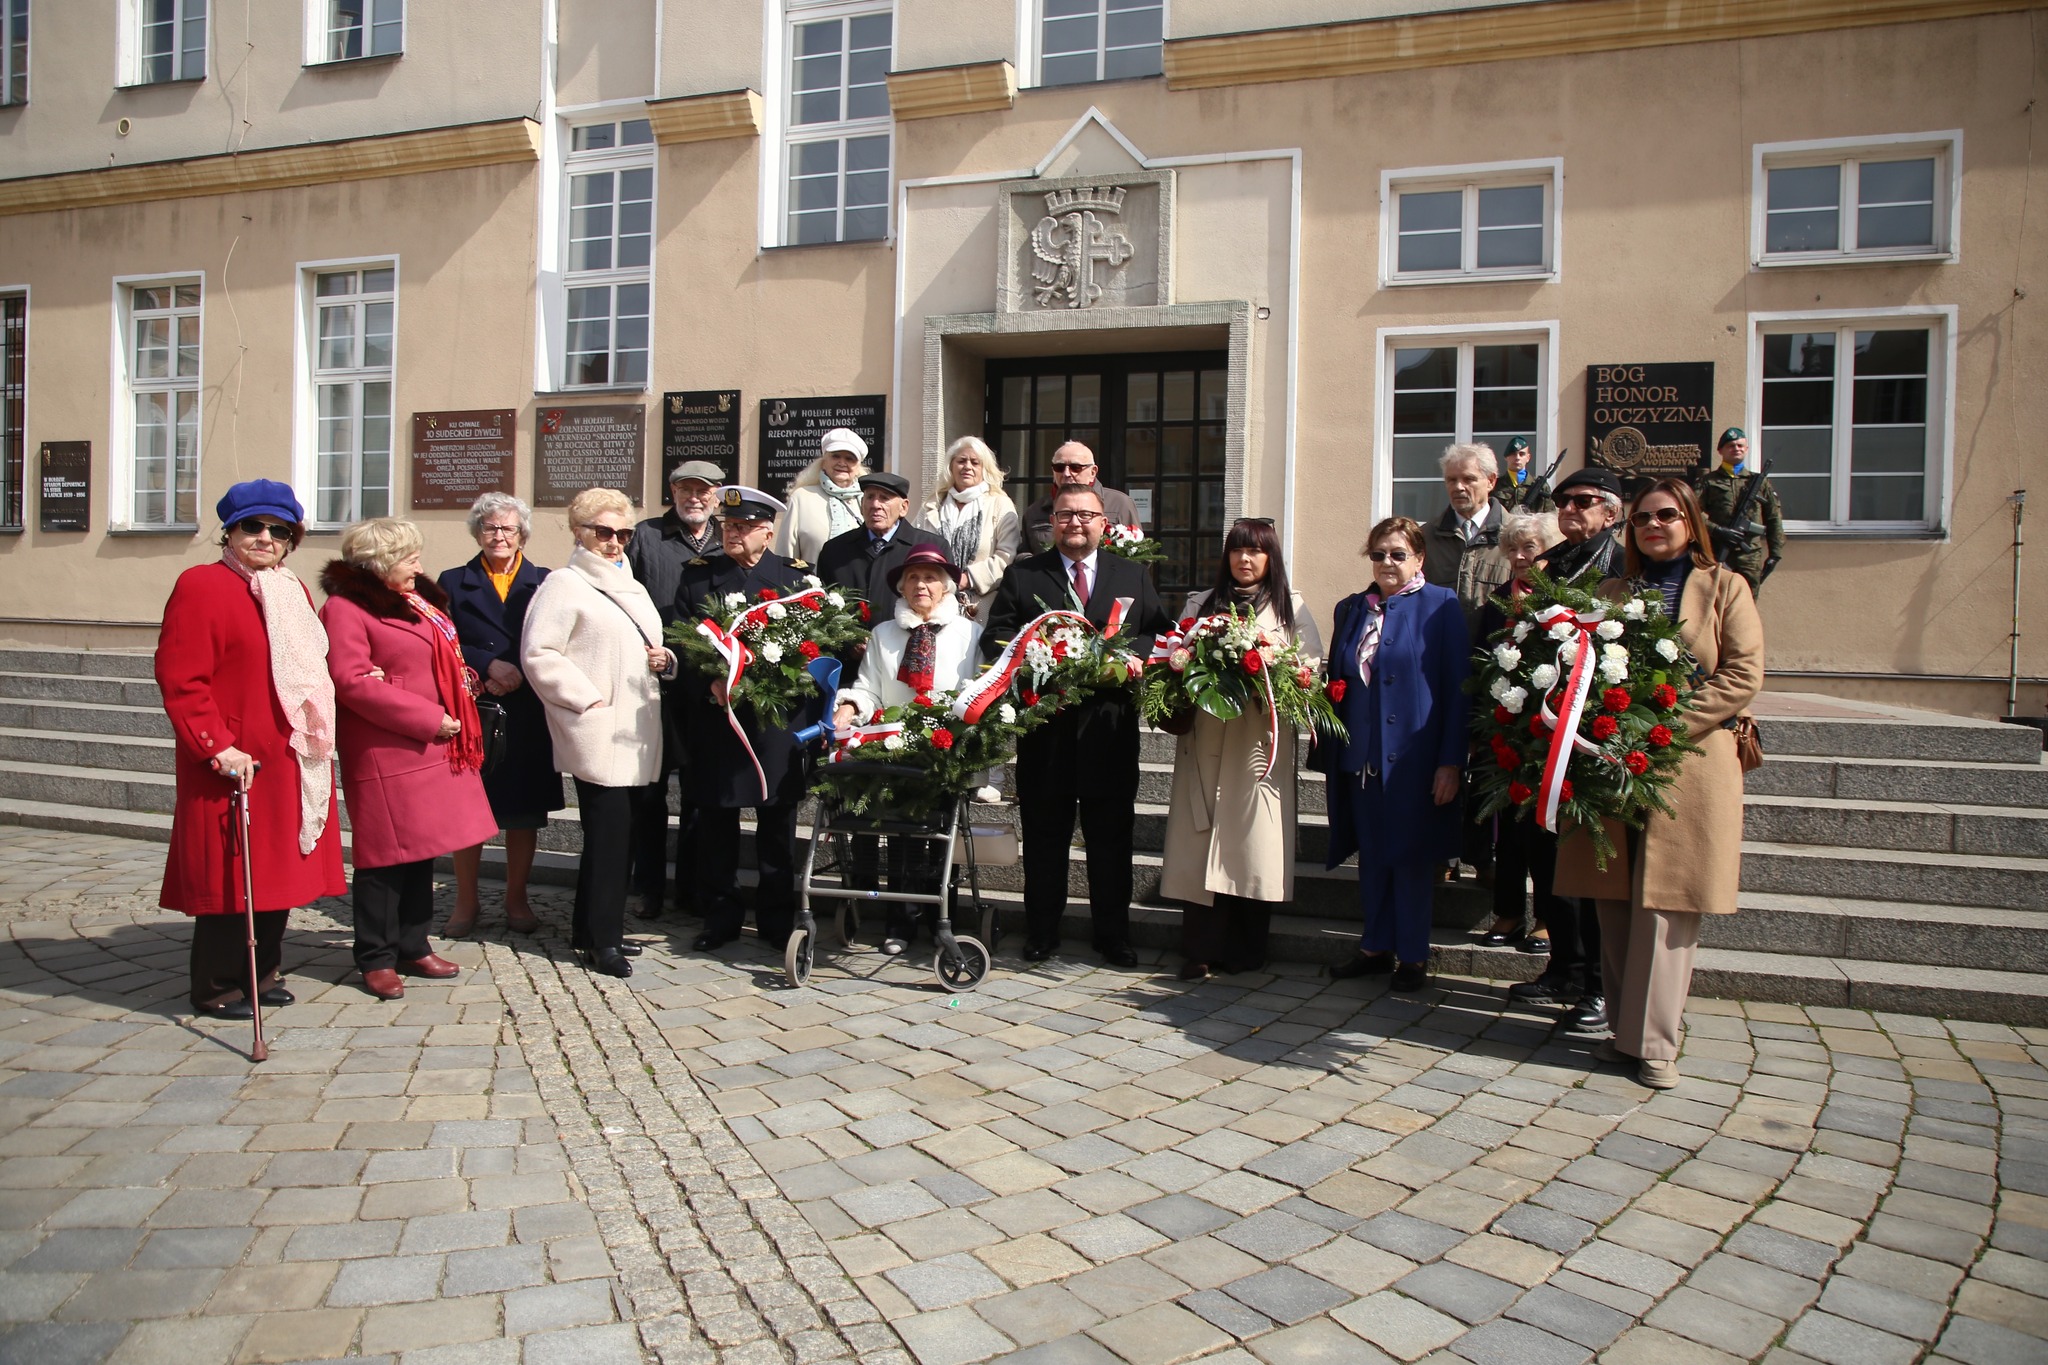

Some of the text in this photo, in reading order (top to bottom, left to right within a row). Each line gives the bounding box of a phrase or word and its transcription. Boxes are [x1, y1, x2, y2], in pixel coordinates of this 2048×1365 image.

[1597, 364, 1645, 384] BÓG
[1596, 386, 1678, 403] HONOR
[684, 406, 716, 414] PAMIĘCI
[802, 409, 832, 417] HOŁDZIE
[836, 408, 874, 416] POLEGŁYM
[1594, 406, 1711, 424] OJCZYZNA
[582, 416, 614, 424] HOŁDZIE
[806, 418, 856, 428] ZA WOLNOŚĆ
[426, 428, 501, 438] 10 SUDECKIEJ DYWIZJI
[559, 424, 606, 433] ŻOŁNIERZOM
[544, 432, 636, 442] PANCERNEGO "SKORPION"
[800, 440, 820, 448] LATAC
[666, 445, 734, 456] SIKORSKIEGO
[1567, 676, 1586, 712] OPOLSKI
